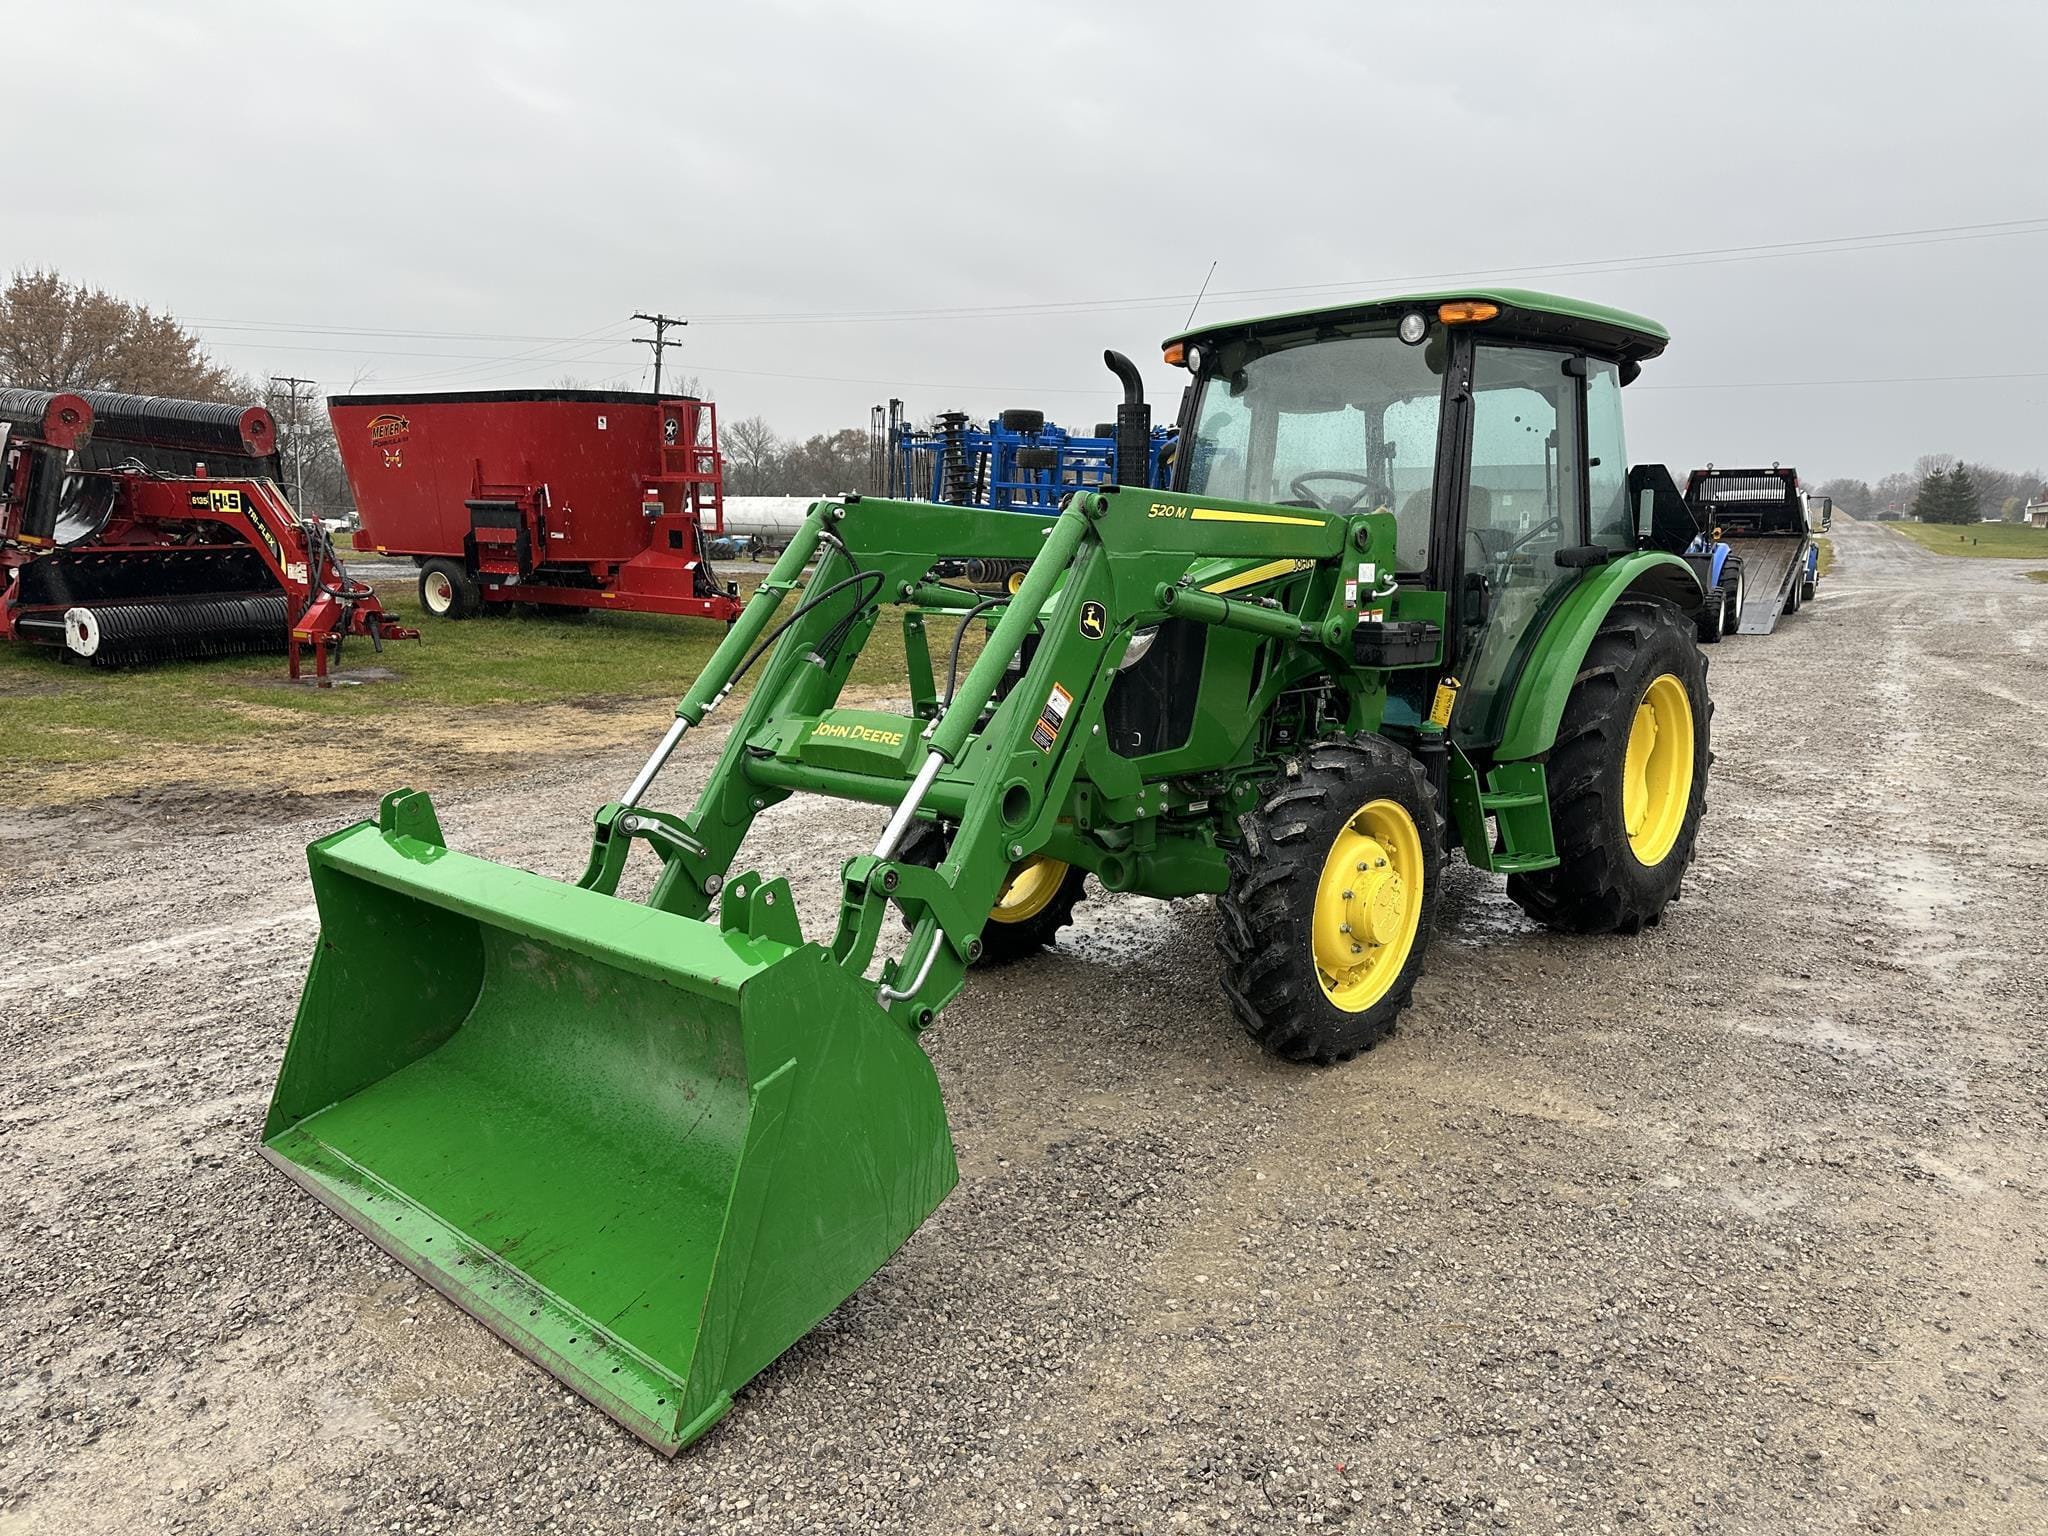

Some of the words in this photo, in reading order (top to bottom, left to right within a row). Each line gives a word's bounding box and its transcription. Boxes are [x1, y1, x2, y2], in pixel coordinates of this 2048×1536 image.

[372, 421, 400, 440] MEYER
[212, 492, 239, 510] H&S
[1148, 503, 1175, 518] 520
[1175, 506, 1188, 519] M
[247, 506, 275, 547] TRI-FLEX
[811, 722, 851, 738] JOHN
[850, 725, 904, 746] DEERE
